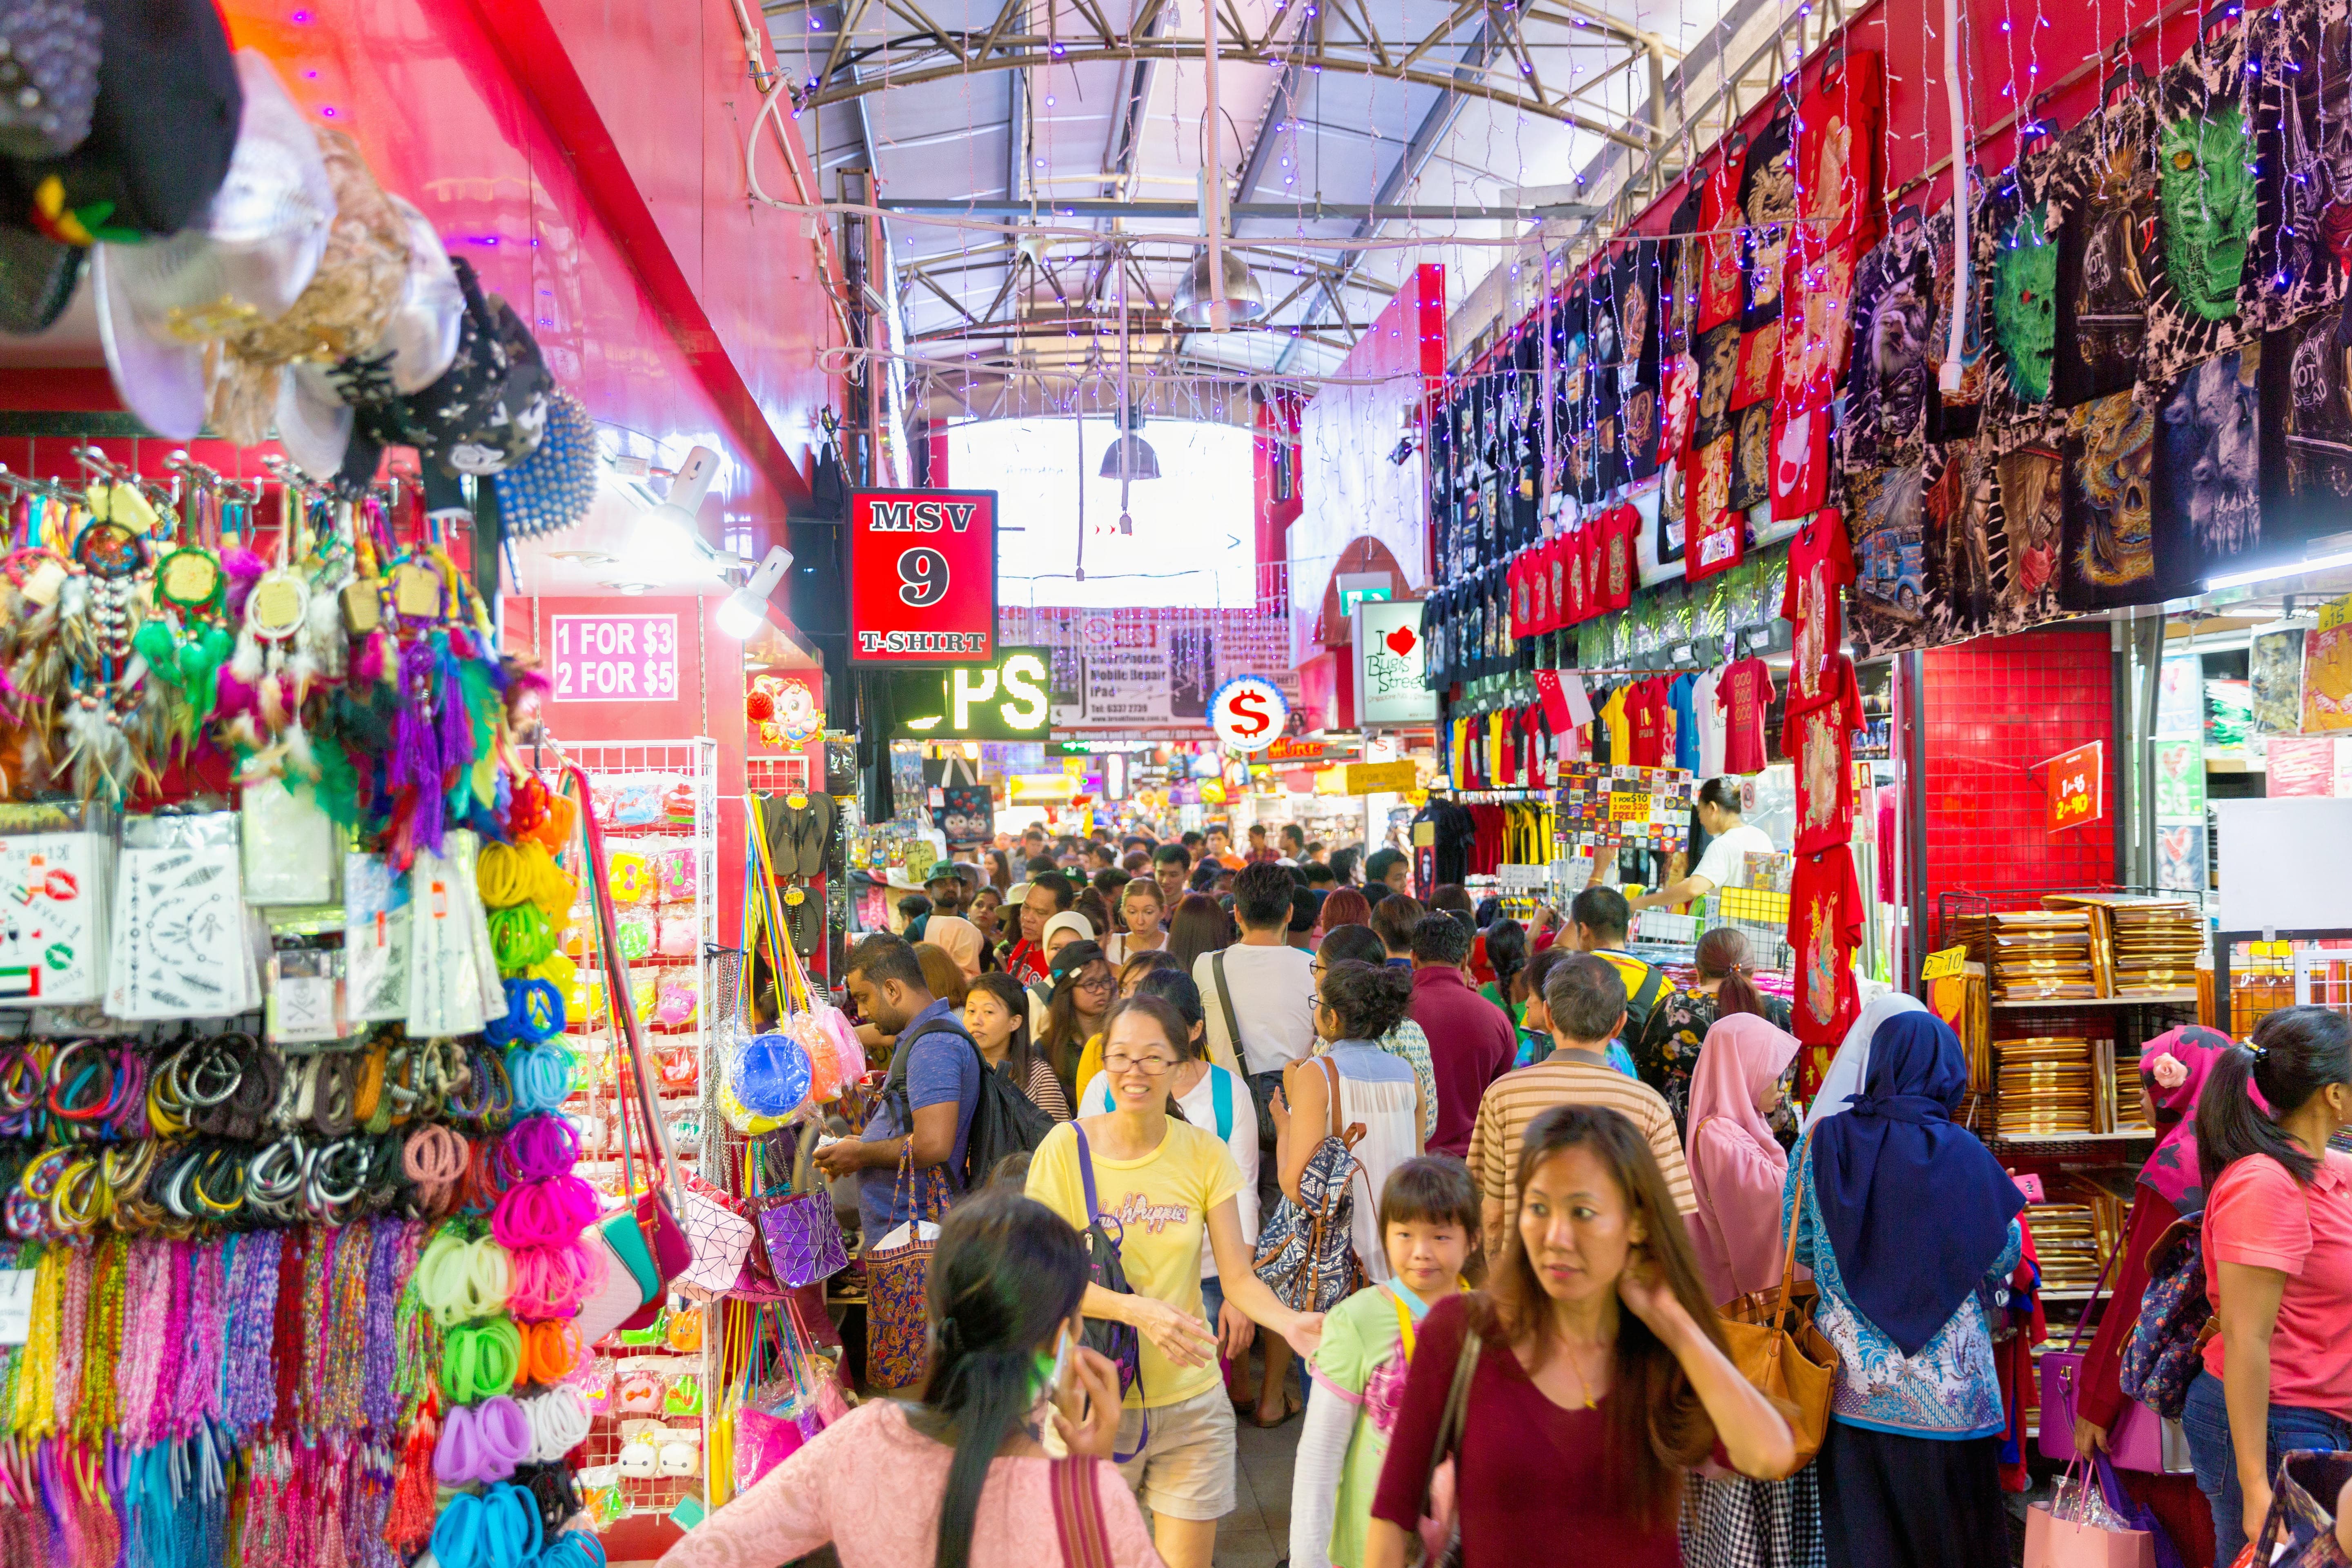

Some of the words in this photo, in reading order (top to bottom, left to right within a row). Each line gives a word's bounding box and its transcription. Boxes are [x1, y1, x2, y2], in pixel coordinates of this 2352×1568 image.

[2293, 377, 2327, 407] DEAD
[870, 501, 976, 532] MSV
[897, 546, 950, 607] 9
[558, 623, 570, 655] 1
[581, 622, 636, 655] FOR
[643, 620, 673, 658] $3
[859, 630, 985, 653] T-SHIRT
[1376, 630, 1385, 655] I
[558, 662, 572, 694] 2
[581, 661, 636, 694] FOR
[643, 659, 673, 697] $5
[1091, 670, 1128, 681] Mobile
[1131, 670, 1165, 682] Repair
[1091, 686, 1115, 697] iPad
[1228, 688, 1270, 739] $
[1631, 793, 1648, 803] $10
[2062, 779, 2067, 797] 1
[1613, 811, 1636, 820] FREE
[1633, 802, 1648, 811] $20
[2056, 801, 2064, 820] 2
[2071, 793, 2088, 814] $10
[1924, 959, 1933, 976] 2
